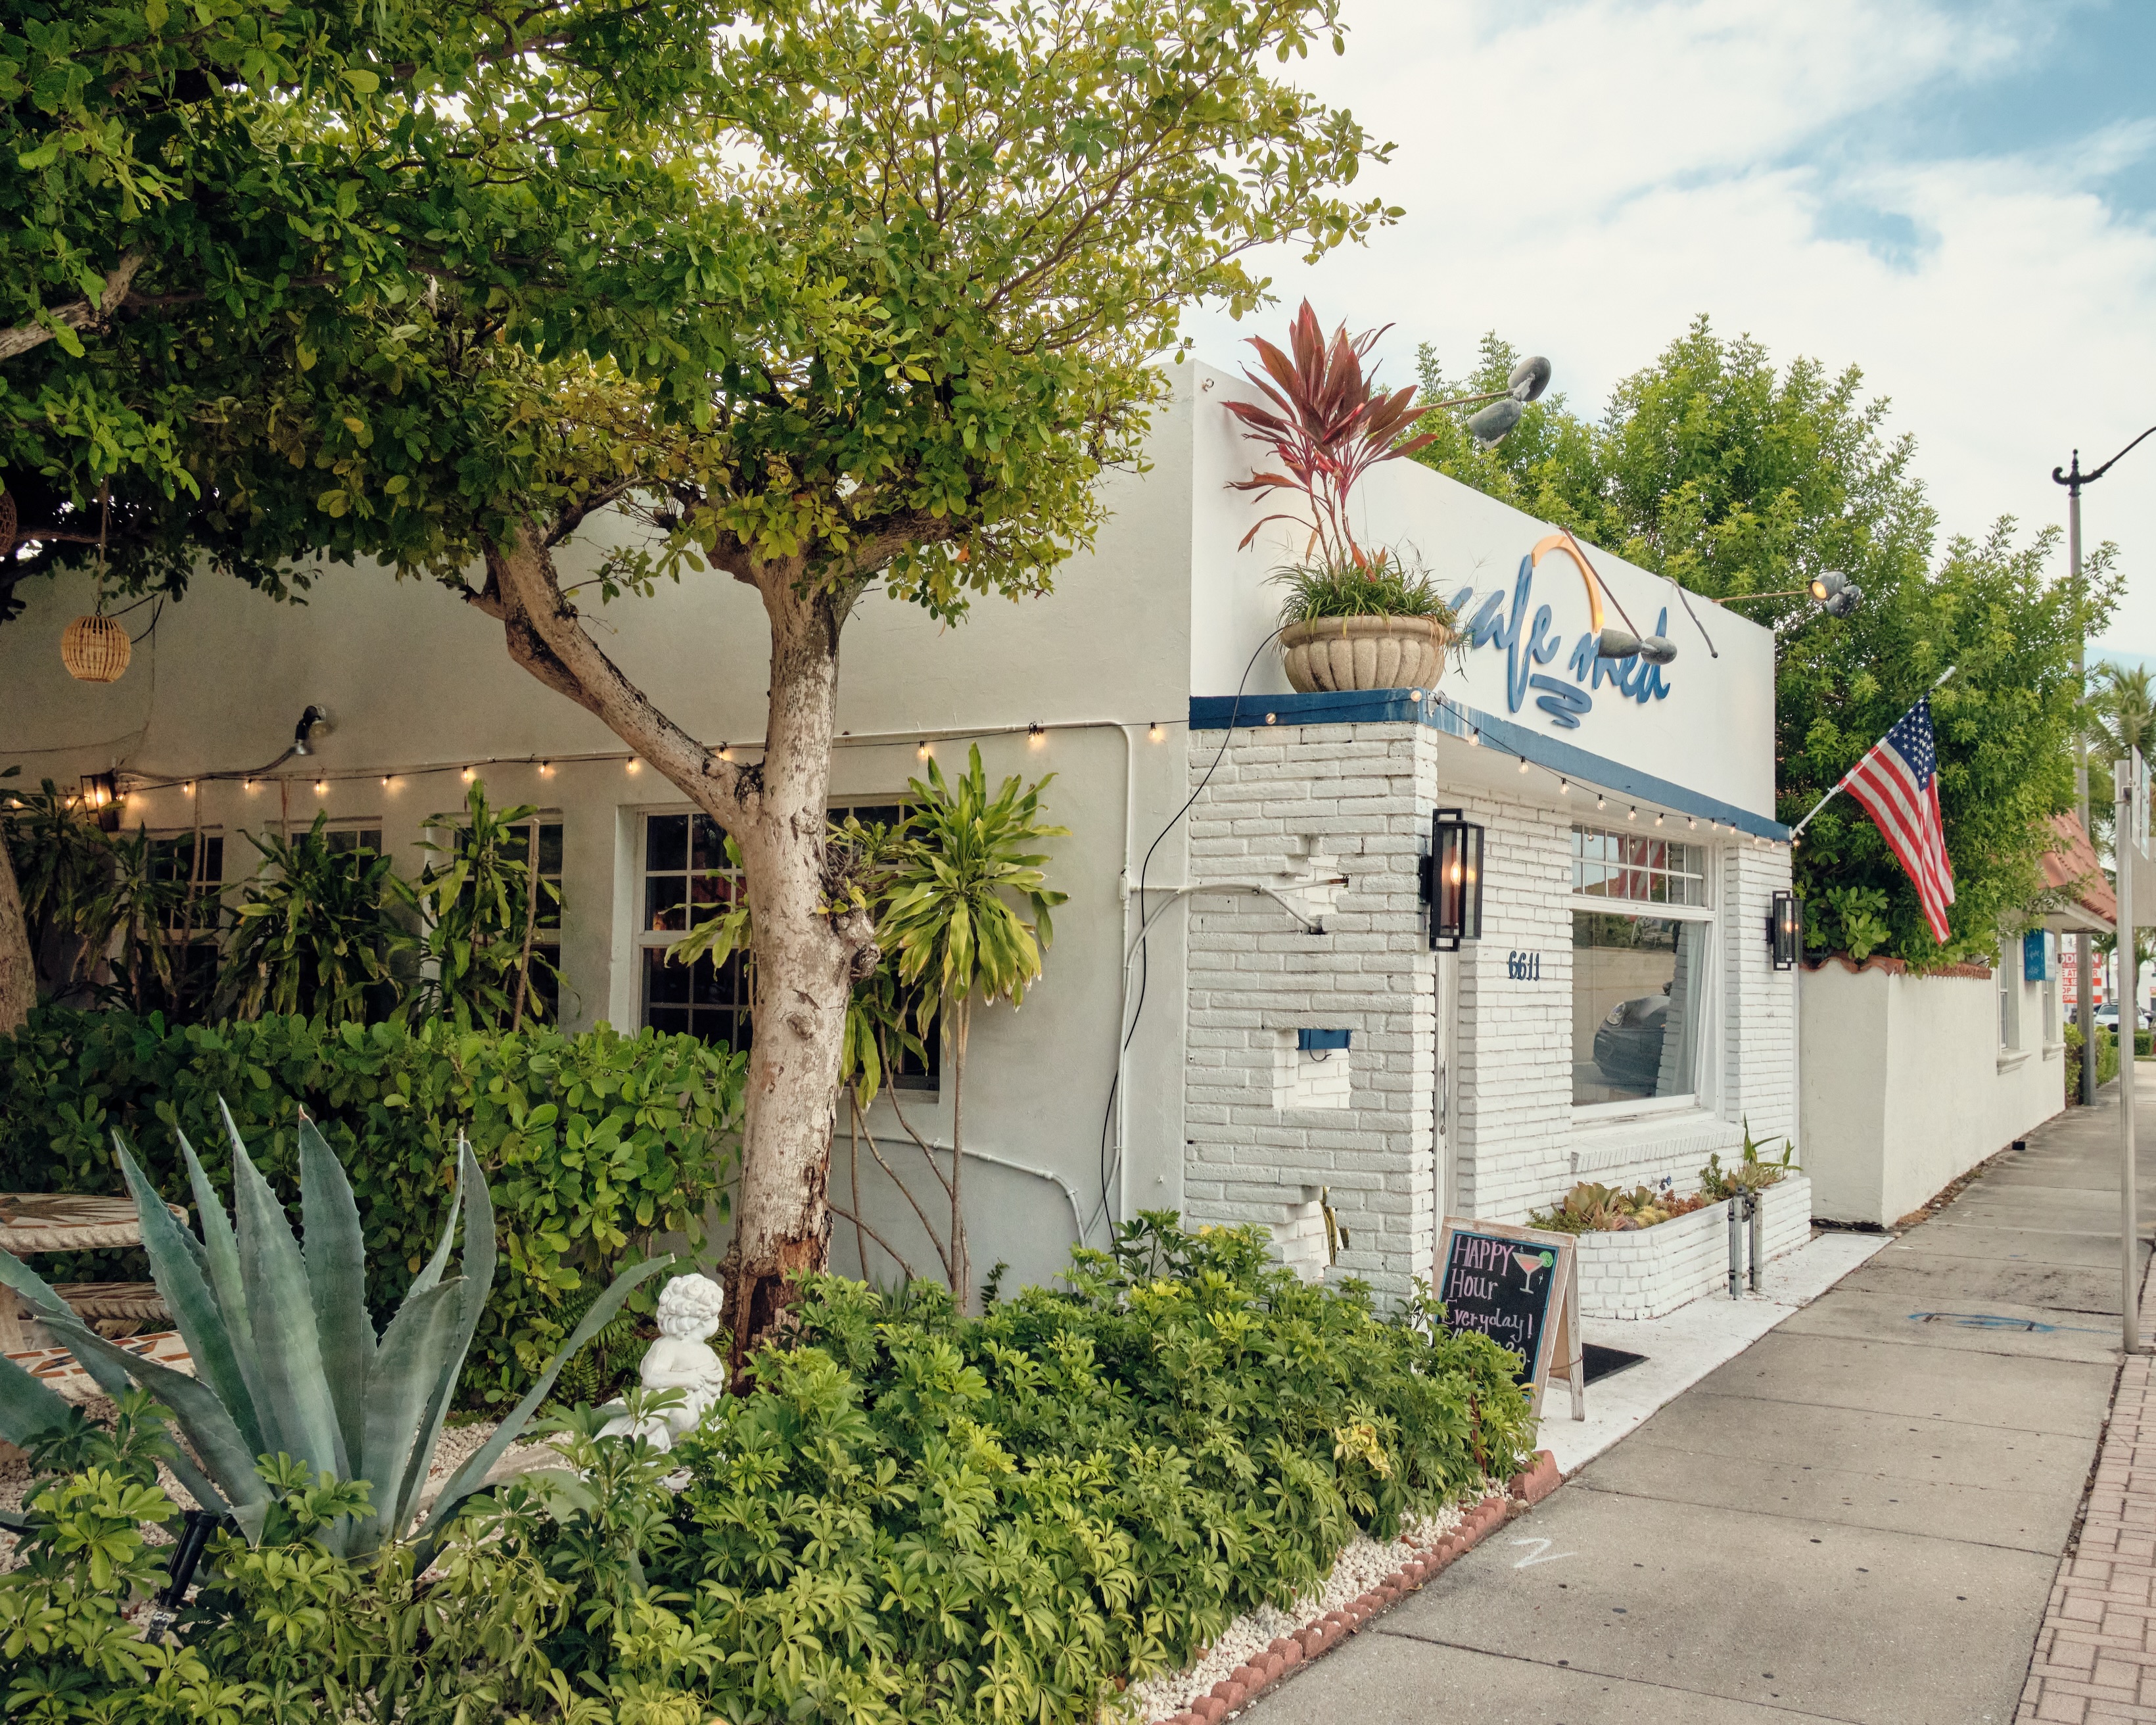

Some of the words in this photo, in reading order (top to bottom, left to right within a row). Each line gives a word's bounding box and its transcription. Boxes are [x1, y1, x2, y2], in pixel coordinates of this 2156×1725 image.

[1508, 951, 1539, 981] 6611
[1452, 1235, 1516, 1277] HAPPY
[1448, 1267, 1499, 1300] Hour
